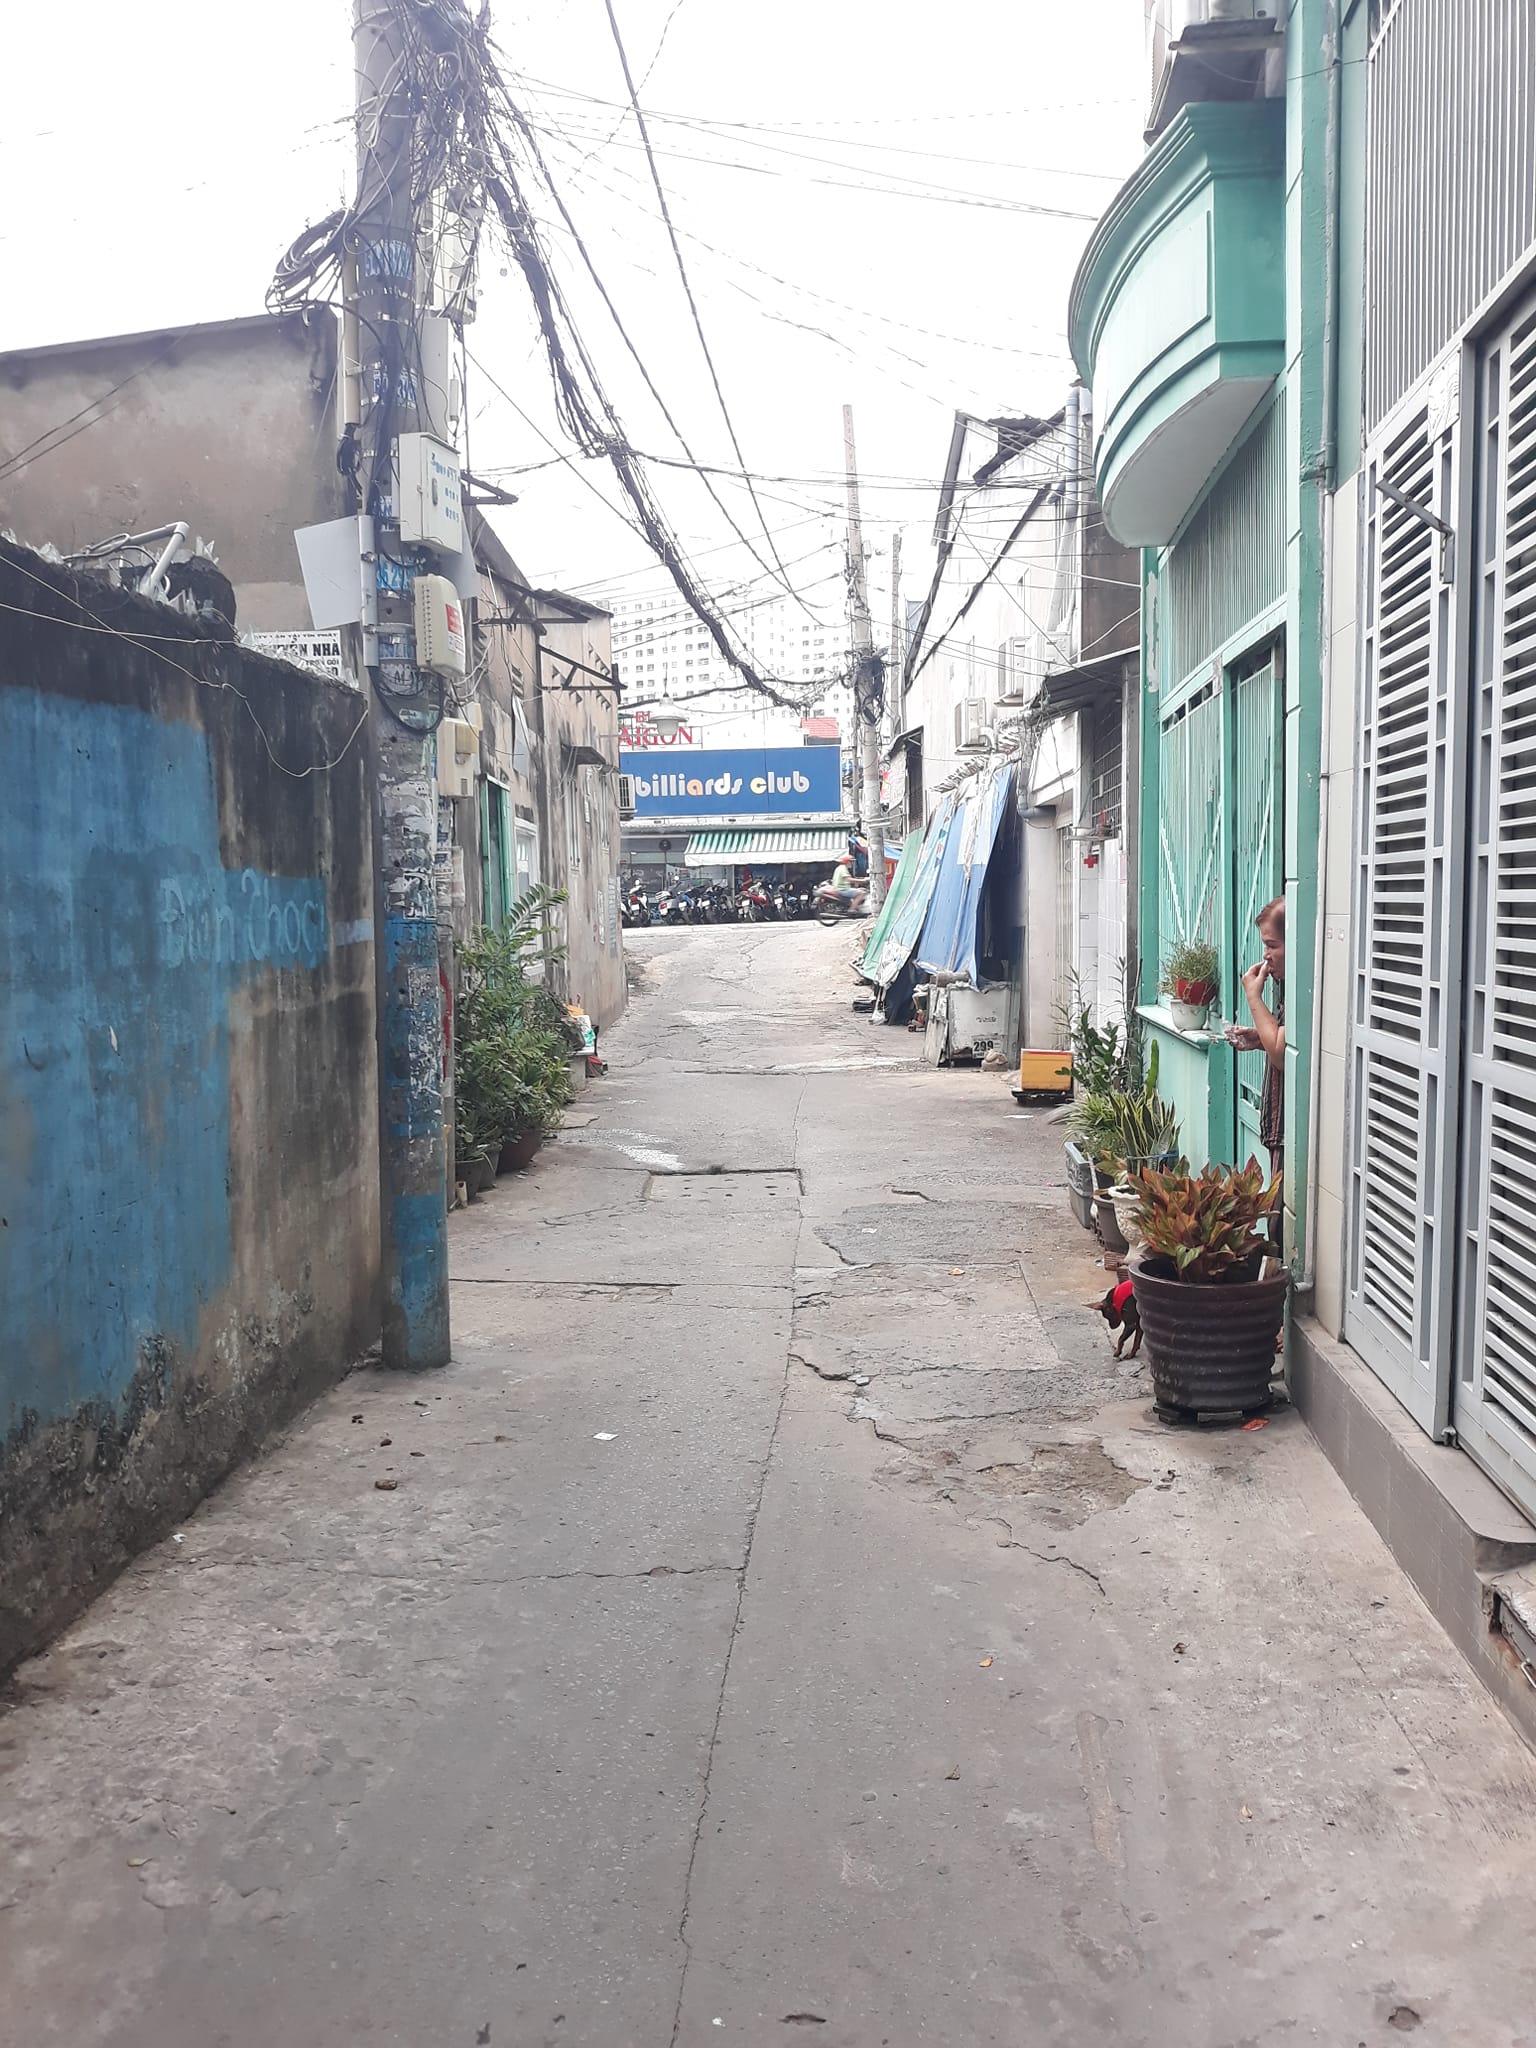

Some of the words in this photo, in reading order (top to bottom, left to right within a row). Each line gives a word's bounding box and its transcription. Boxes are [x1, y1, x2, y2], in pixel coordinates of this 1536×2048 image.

[313, 639, 340, 656] NHÀ
[635, 772, 743, 798] billiards
[750, 771, 810, 795] club
[974, 1041, 994, 1052] 299
